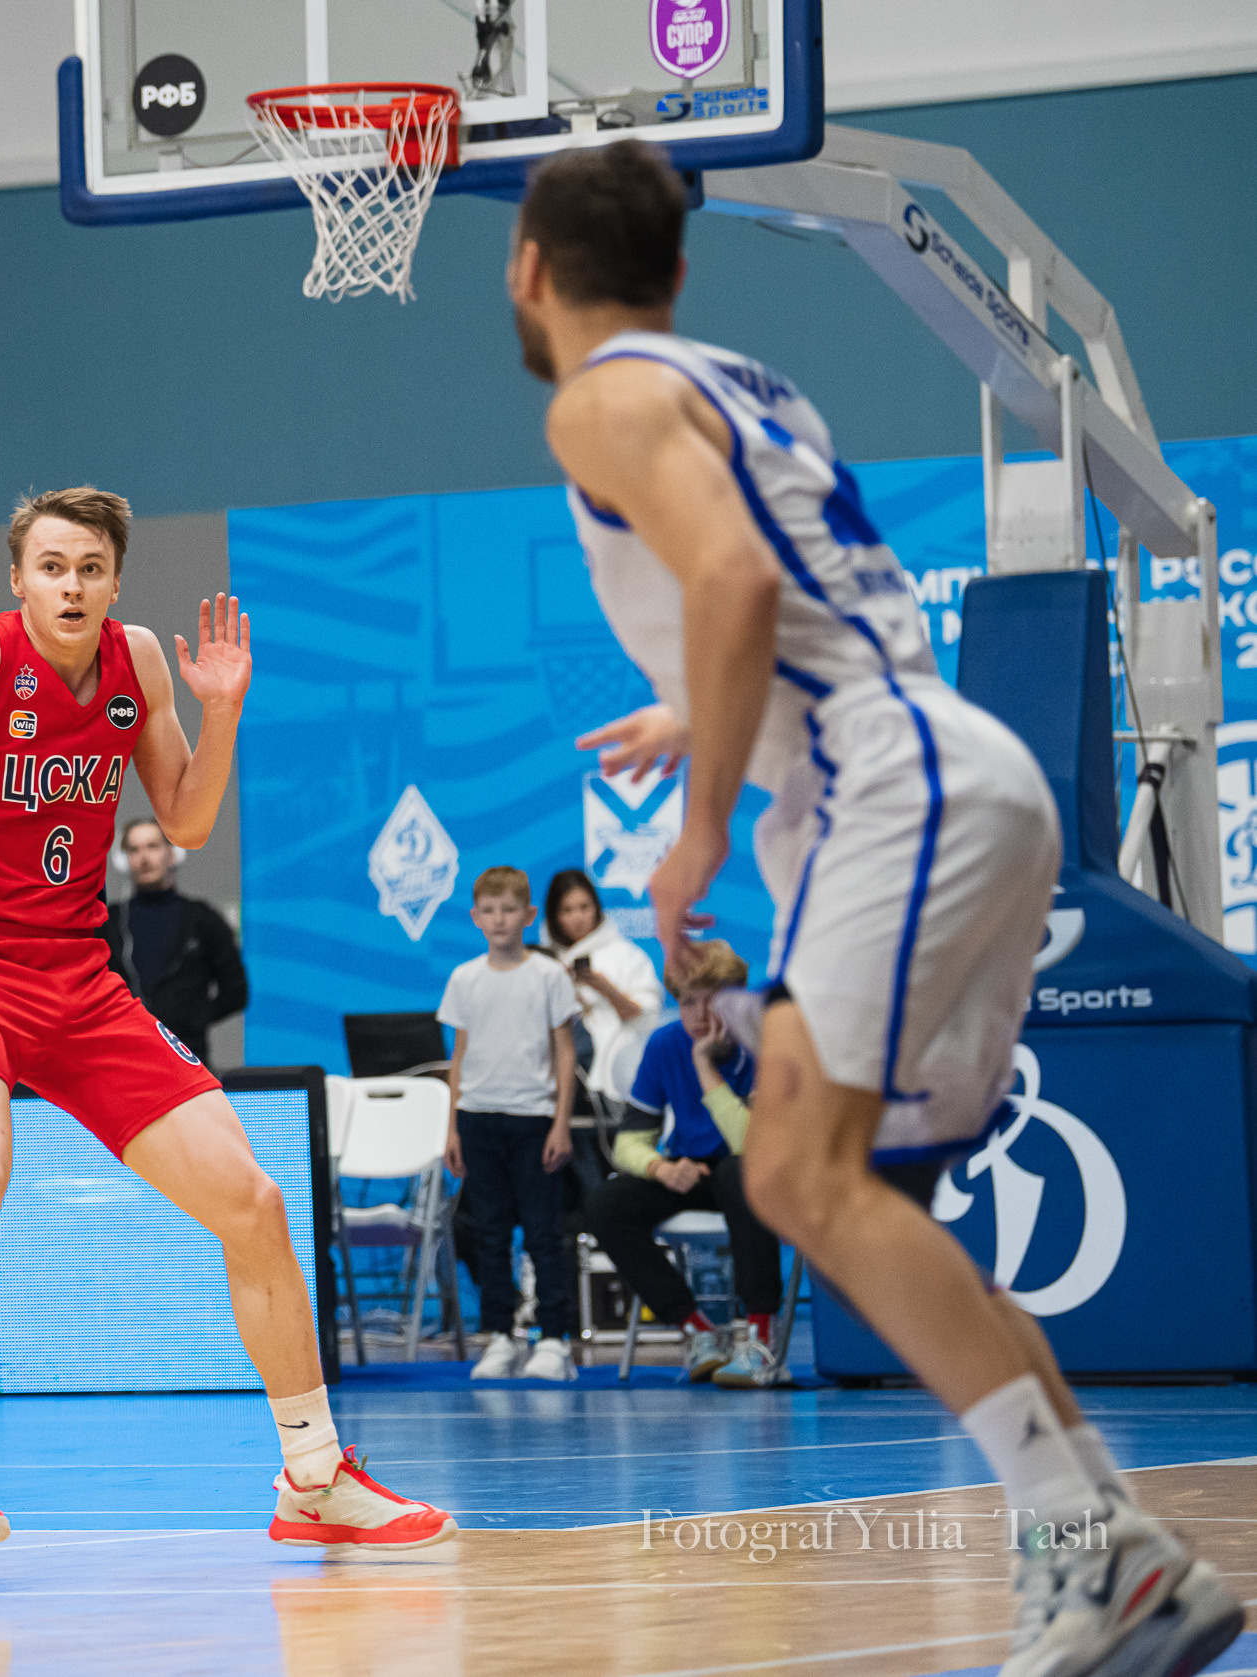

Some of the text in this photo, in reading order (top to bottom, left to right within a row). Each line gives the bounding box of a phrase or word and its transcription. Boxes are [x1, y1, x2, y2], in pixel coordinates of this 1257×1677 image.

[141, 82, 197, 110] РФБ
[16, 678, 35, 688] CSKA
[110, 707, 135, 718] РФБ
[2, 754, 123, 813] ЦСКА
[42, 825, 74, 885] 6
[1037, 984, 1153, 1016] Sports
